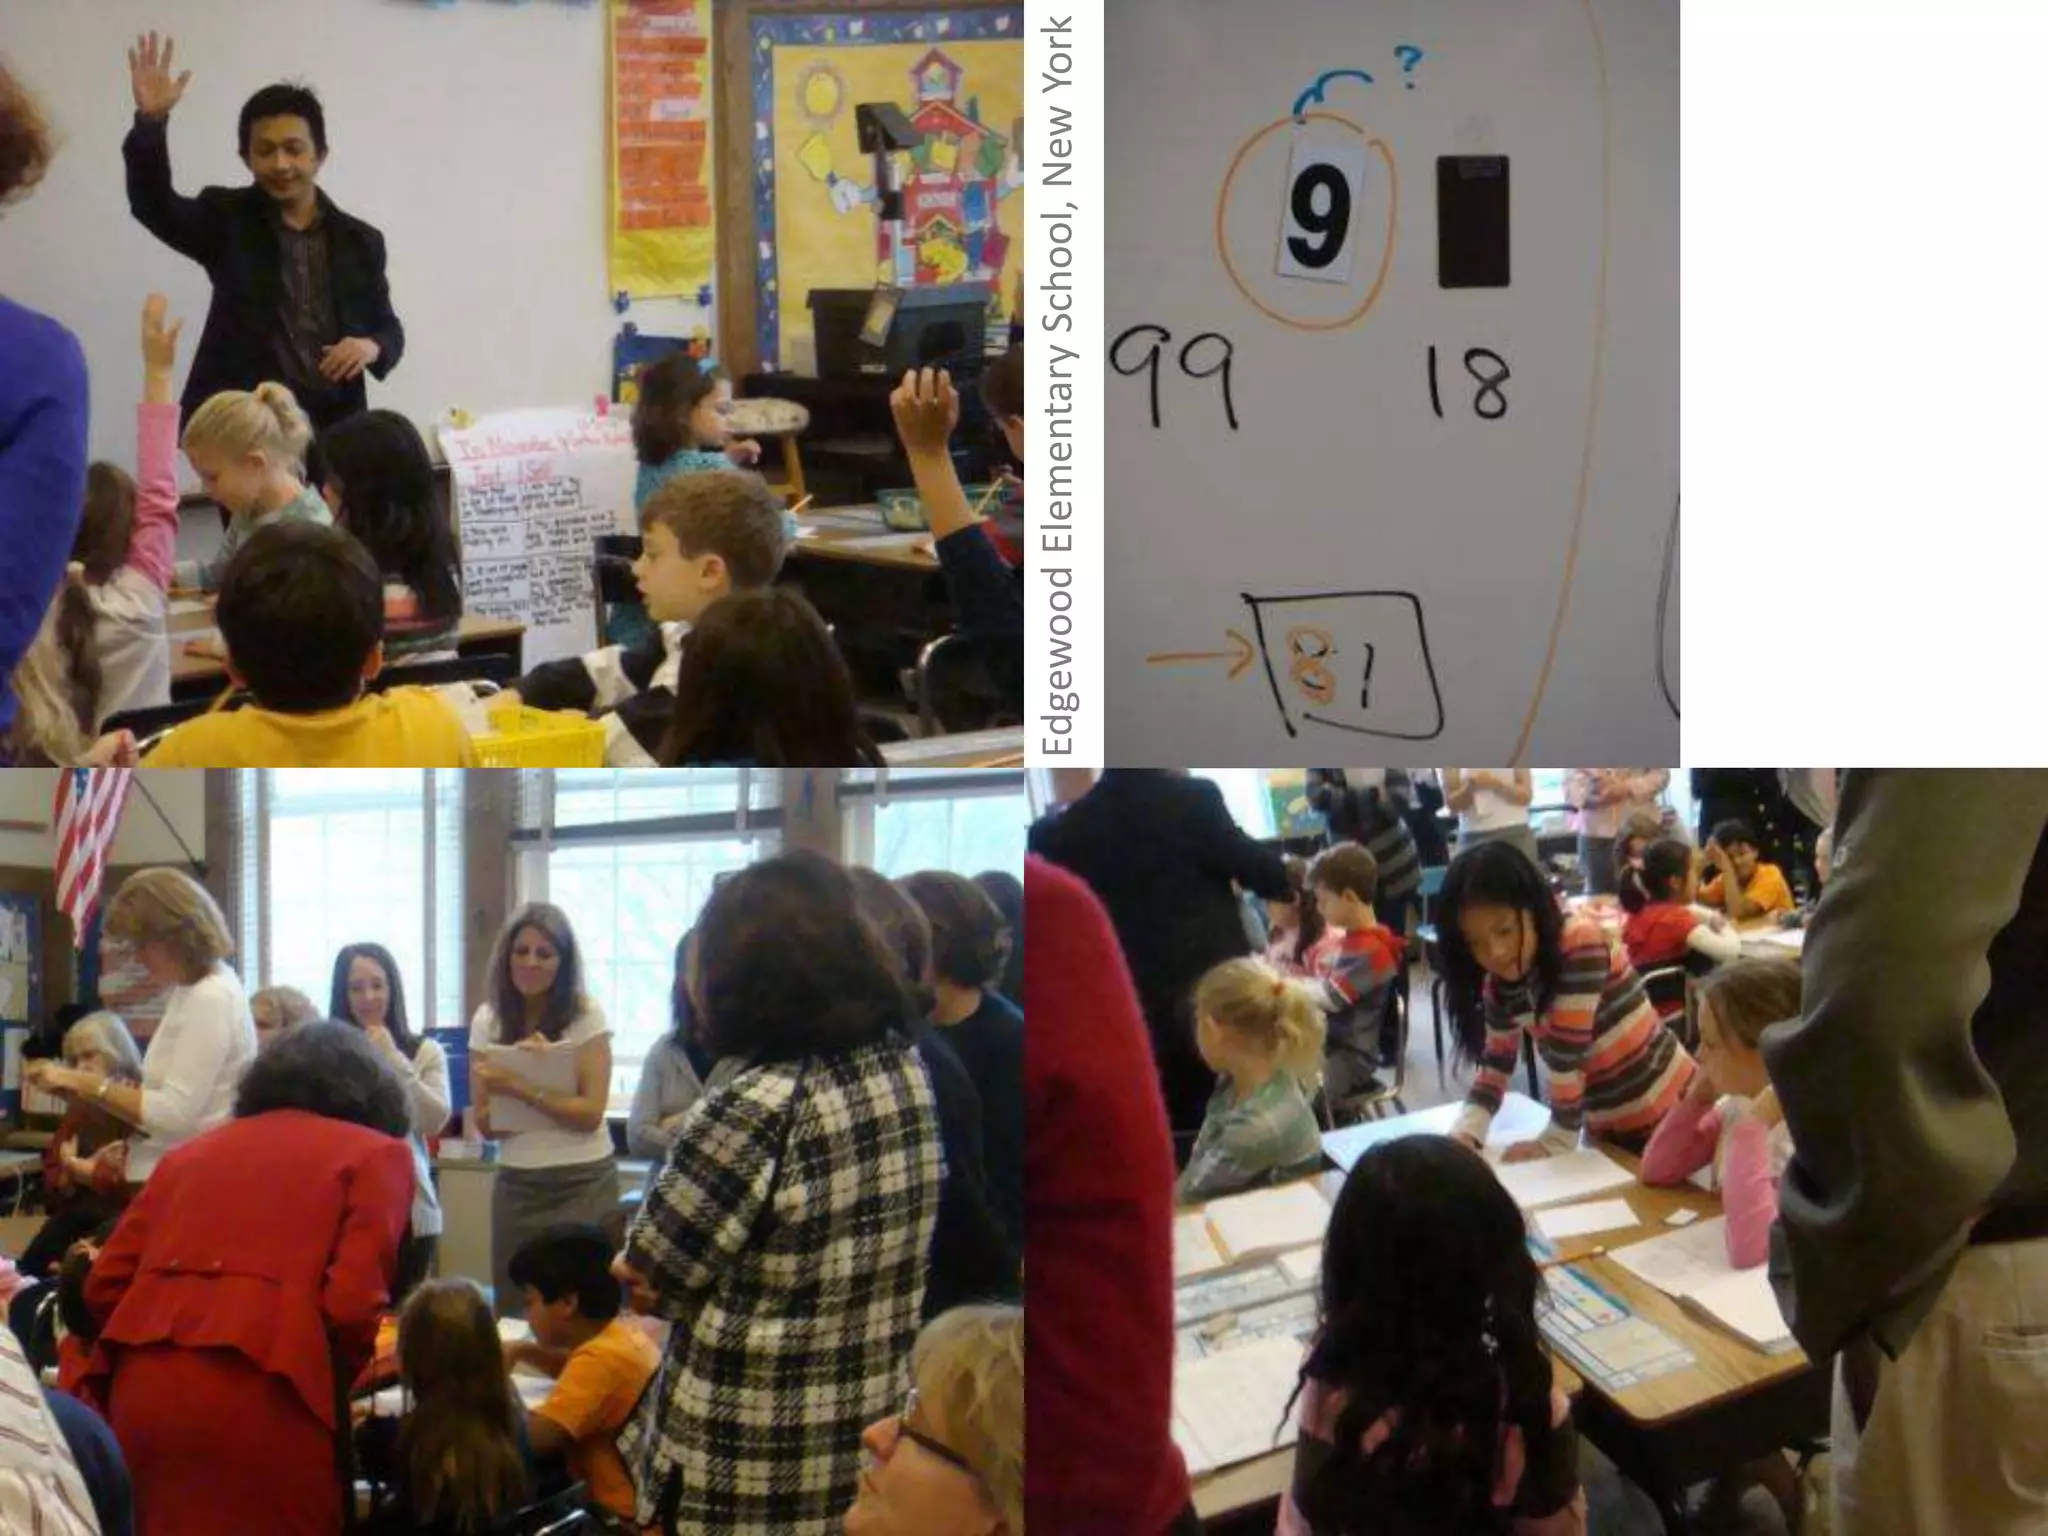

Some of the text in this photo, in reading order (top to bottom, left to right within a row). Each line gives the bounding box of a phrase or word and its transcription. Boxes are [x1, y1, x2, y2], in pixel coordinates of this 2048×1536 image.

[1287, 163, 1351, 269] 9
[1108, 324, 1239, 431] 99
[1427, 345, 1511, 420] 18
